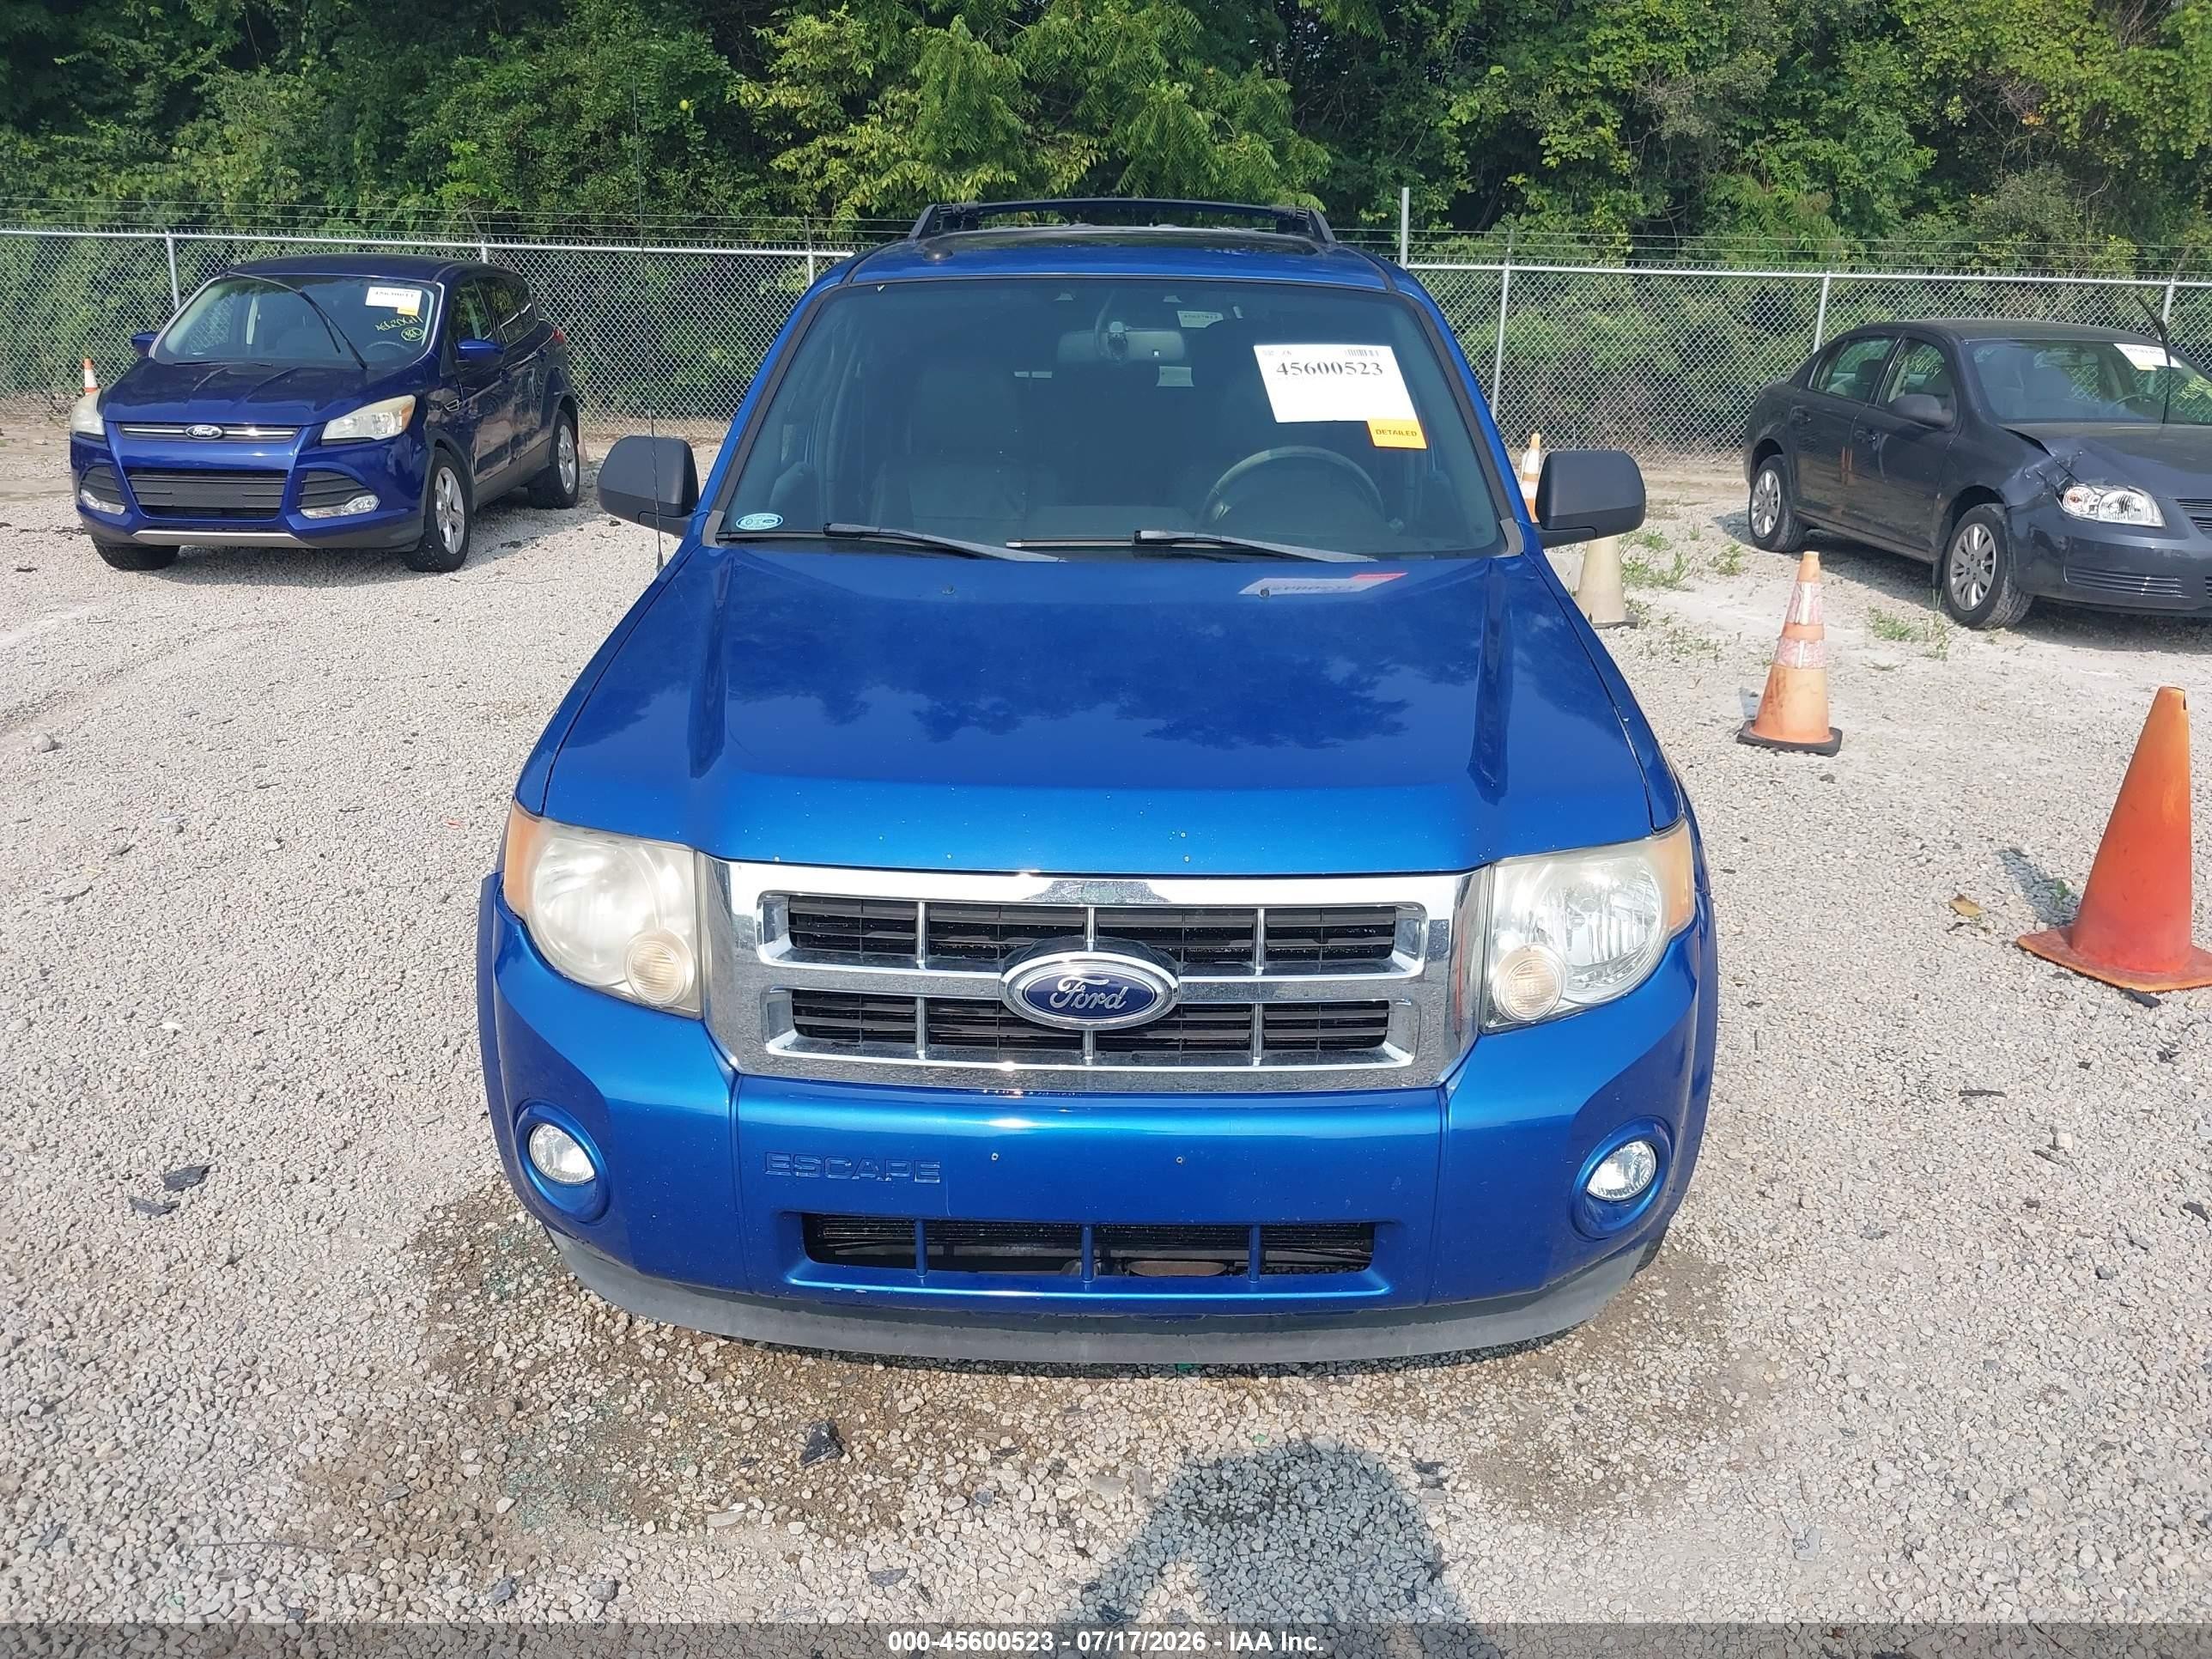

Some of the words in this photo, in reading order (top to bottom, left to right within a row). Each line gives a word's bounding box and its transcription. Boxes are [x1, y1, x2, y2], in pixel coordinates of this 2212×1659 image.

[1276, 362, 1383, 376] 45600523
[1375, 428, 1417, 438] DETAILED
[1048, 975, 1127, 1010] Ford
[763, 1151, 941, 1183] ESCAPE
